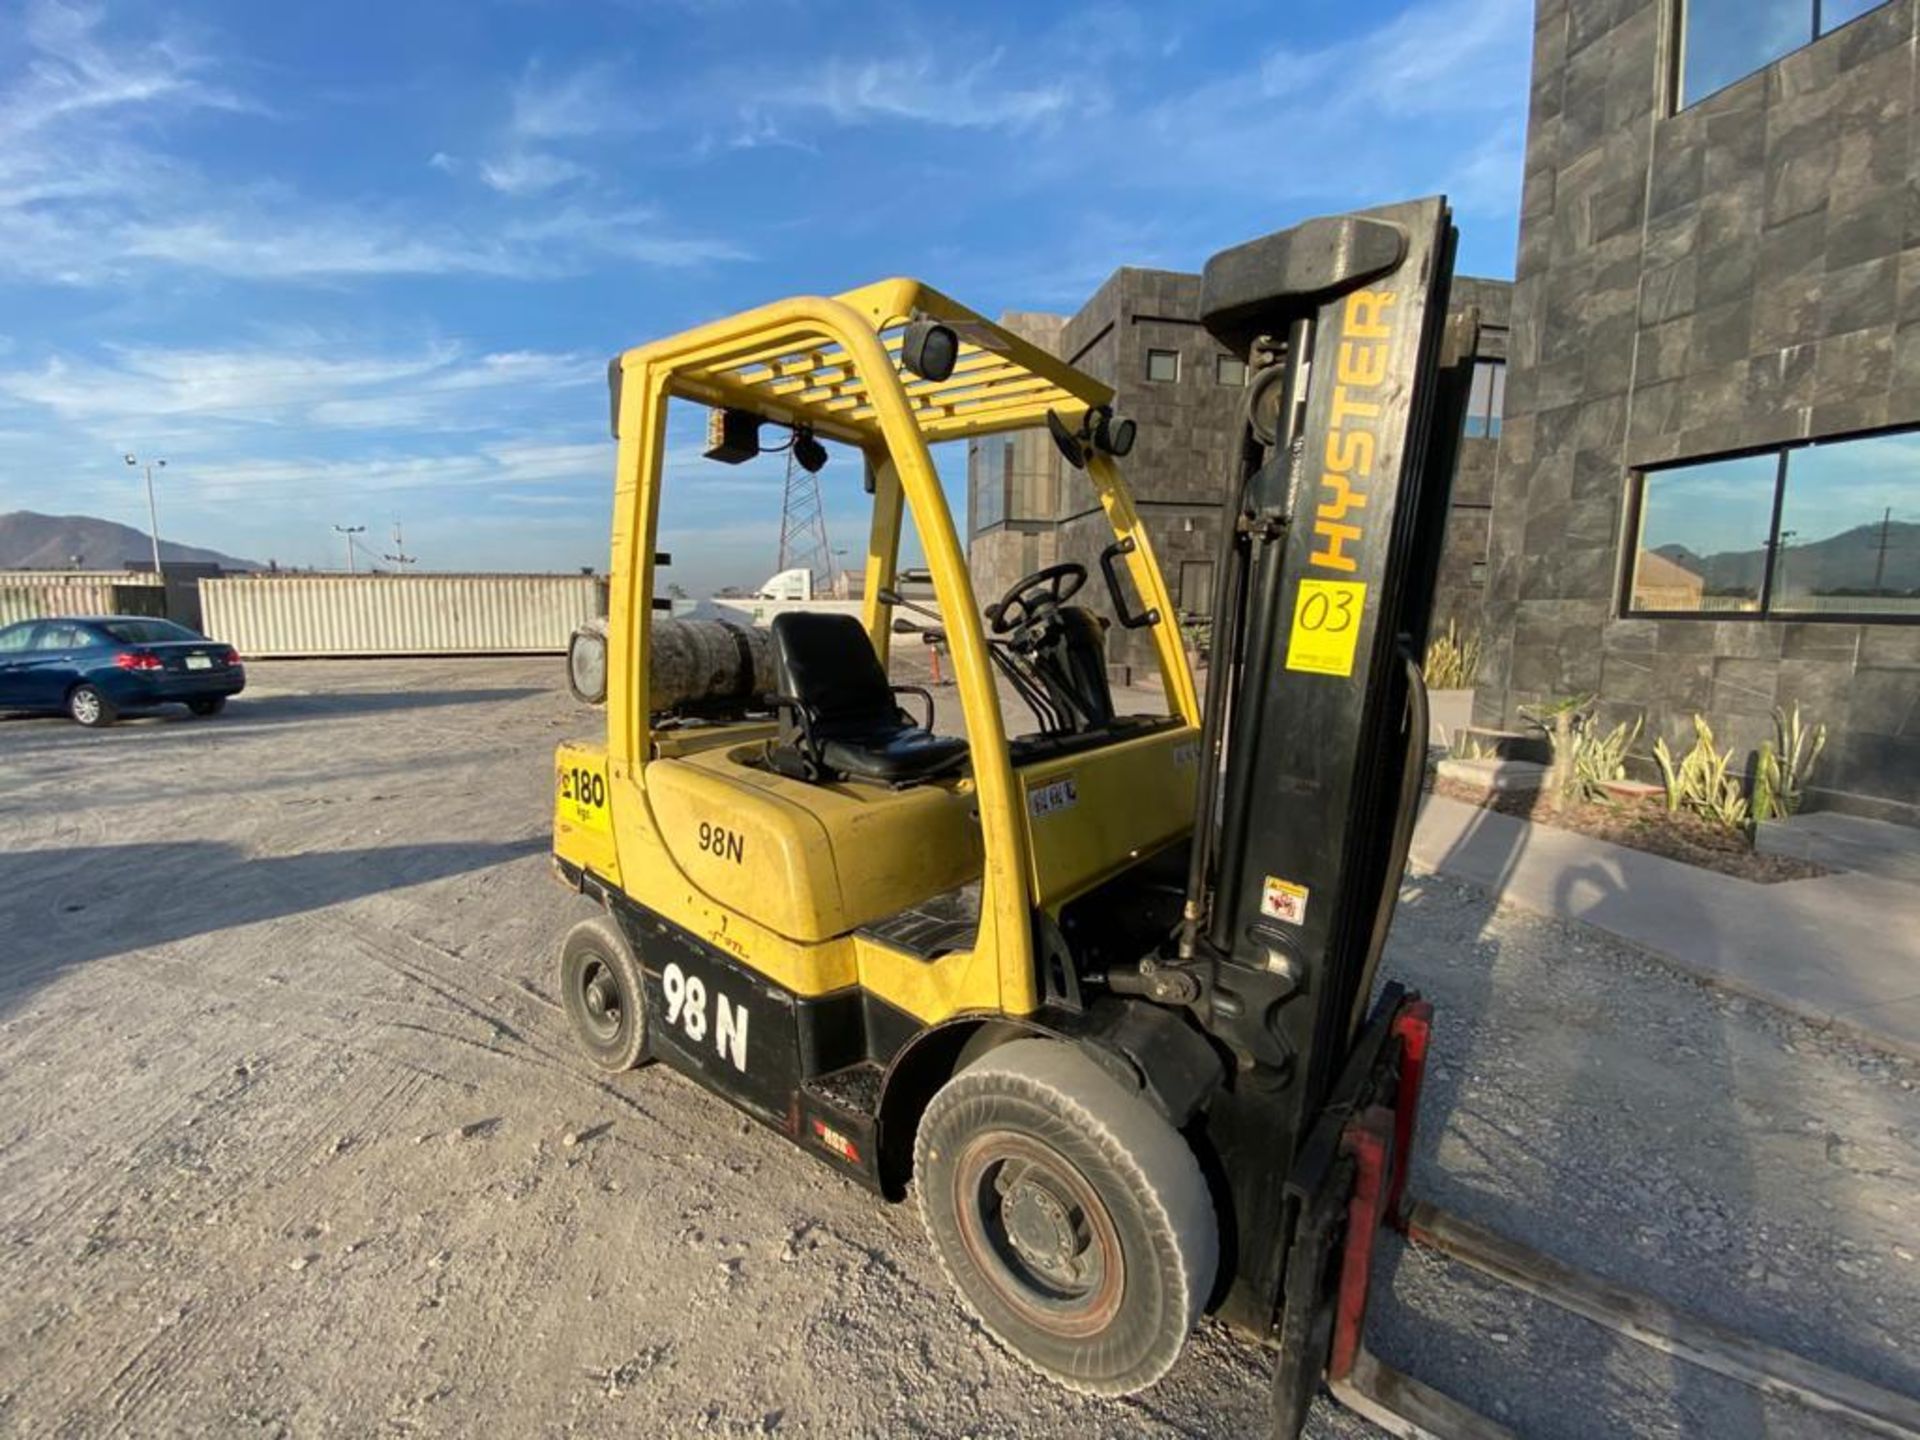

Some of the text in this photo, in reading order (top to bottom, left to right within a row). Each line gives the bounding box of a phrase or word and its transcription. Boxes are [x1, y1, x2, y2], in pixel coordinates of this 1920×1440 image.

[1310, 289, 1397, 572] HYSTER
[1299, 590, 1353, 632] 03
[699, 822, 744, 865] 98N
[663, 962, 748, 1073] 98 N
